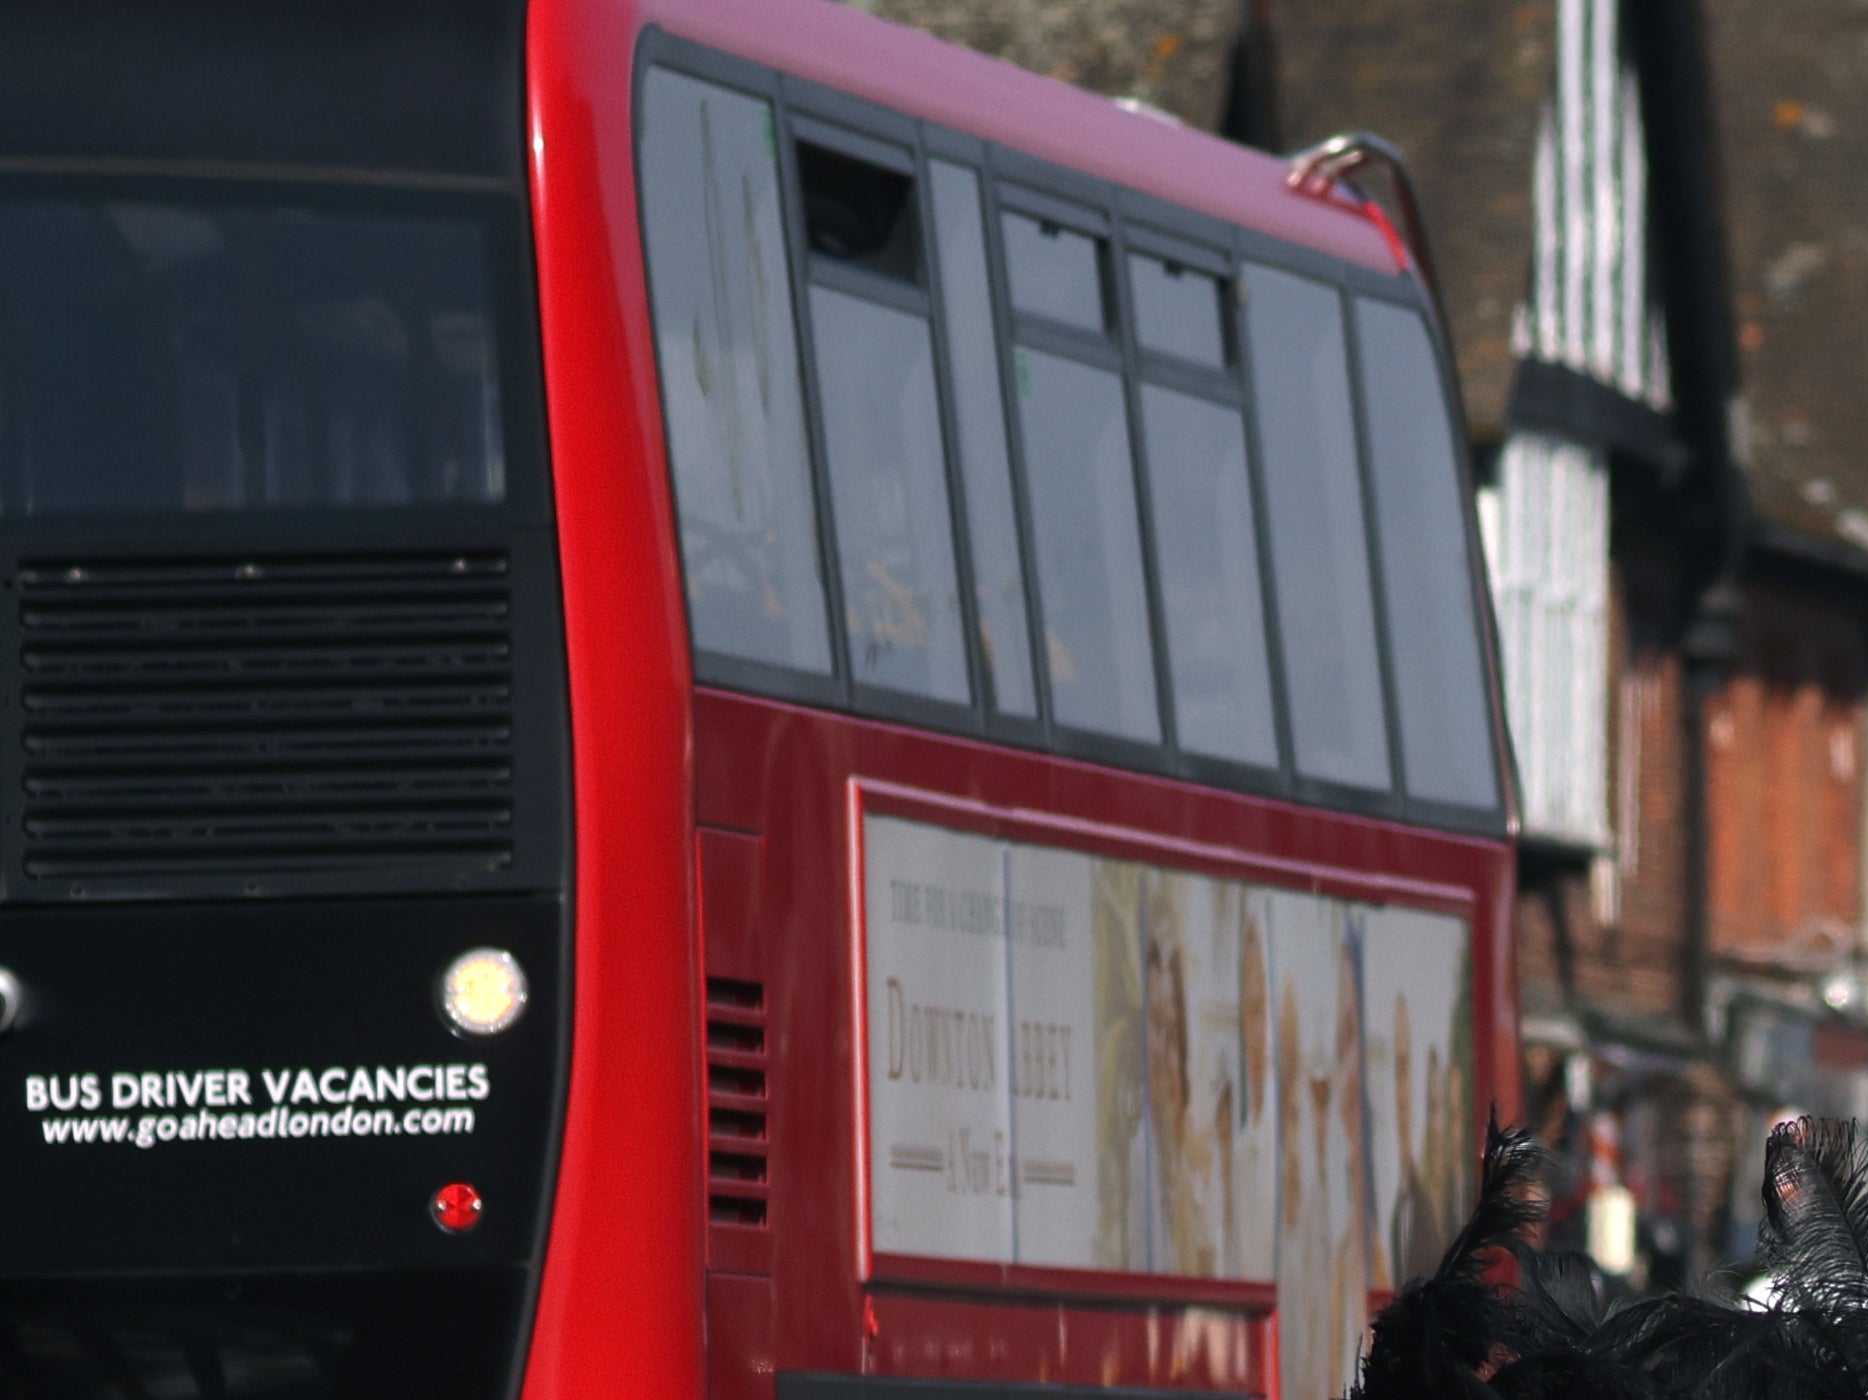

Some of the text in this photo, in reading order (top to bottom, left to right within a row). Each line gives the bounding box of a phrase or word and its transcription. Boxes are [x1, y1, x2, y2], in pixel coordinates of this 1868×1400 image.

[26, 1063, 490, 1111] BUS DRIVER VACANCIES
[42, 1104, 476, 1149] www.goaheadlondon.com
